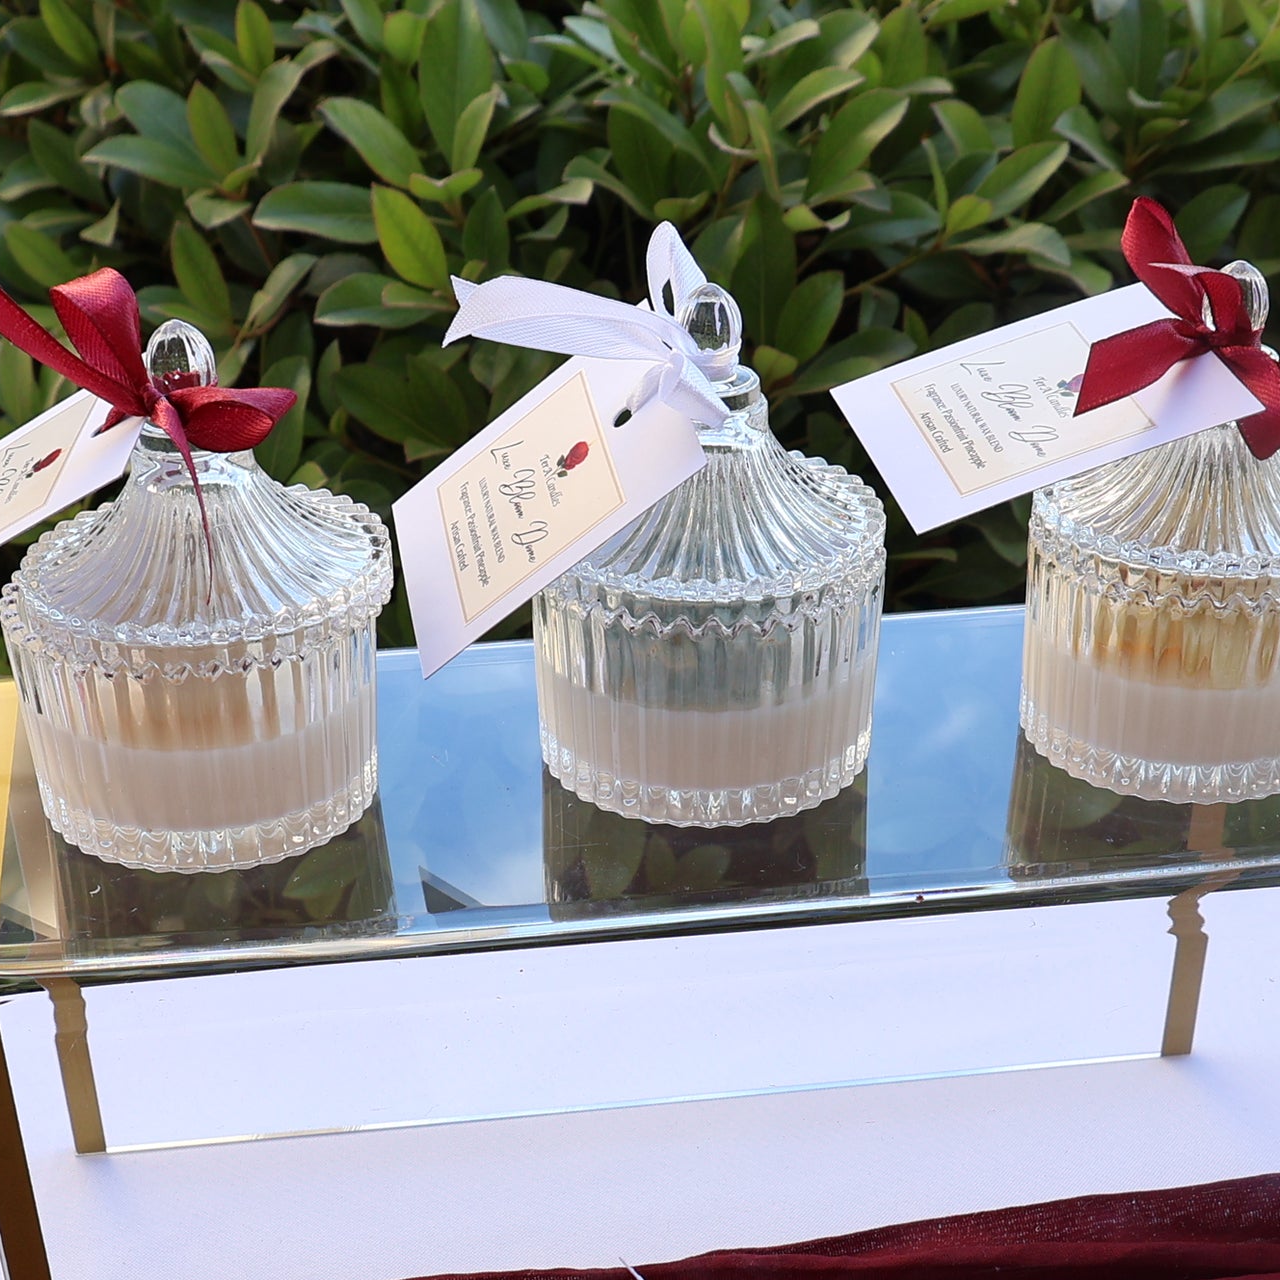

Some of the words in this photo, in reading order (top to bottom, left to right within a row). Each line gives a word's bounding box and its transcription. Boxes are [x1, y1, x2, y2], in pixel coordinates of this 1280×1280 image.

[959, 361, 1006, 383] Luxe
[950, 383, 970, 402] LUXURY
[980, 384, 1034, 422] Bloom
[1046, 392, 1071, 418] Candles
[925, 383, 947, 410] Fragrance:
[941, 408, 969, 442] Passionfruit
[961, 439, 987, 469] Pineapple
[962, 400, 984, 425] NATURAL
[919, 412, 937, 432] Artisan
[931, 430, 954, 453] Crafted
[978, 422, 993, 436] WAX
[985, 434, 1004, 453] BLEND
[1008, 425, 1060, 458] Dome
[490, 440, 524, 470] Luxe
[478, 477, 490, 502] LUXURY
[498, 468, 536, 519] Bloom
[545, 472, 563, 508] Candles
[484, 499, 496, 529] NATURAL
[450, 520, 461, 546] Artisan
[459, 481, 472, 517] Fragrance:
[466, 512, 483, 555] Passionfruit
[475, 550, 491, 588] Pineapple
[490, 525, 500, 543] WAX
[510, 520, 549, 563] Dome
[455, 543, 470, 572] Crafted
[493, 540, 505, 563] BLEND
